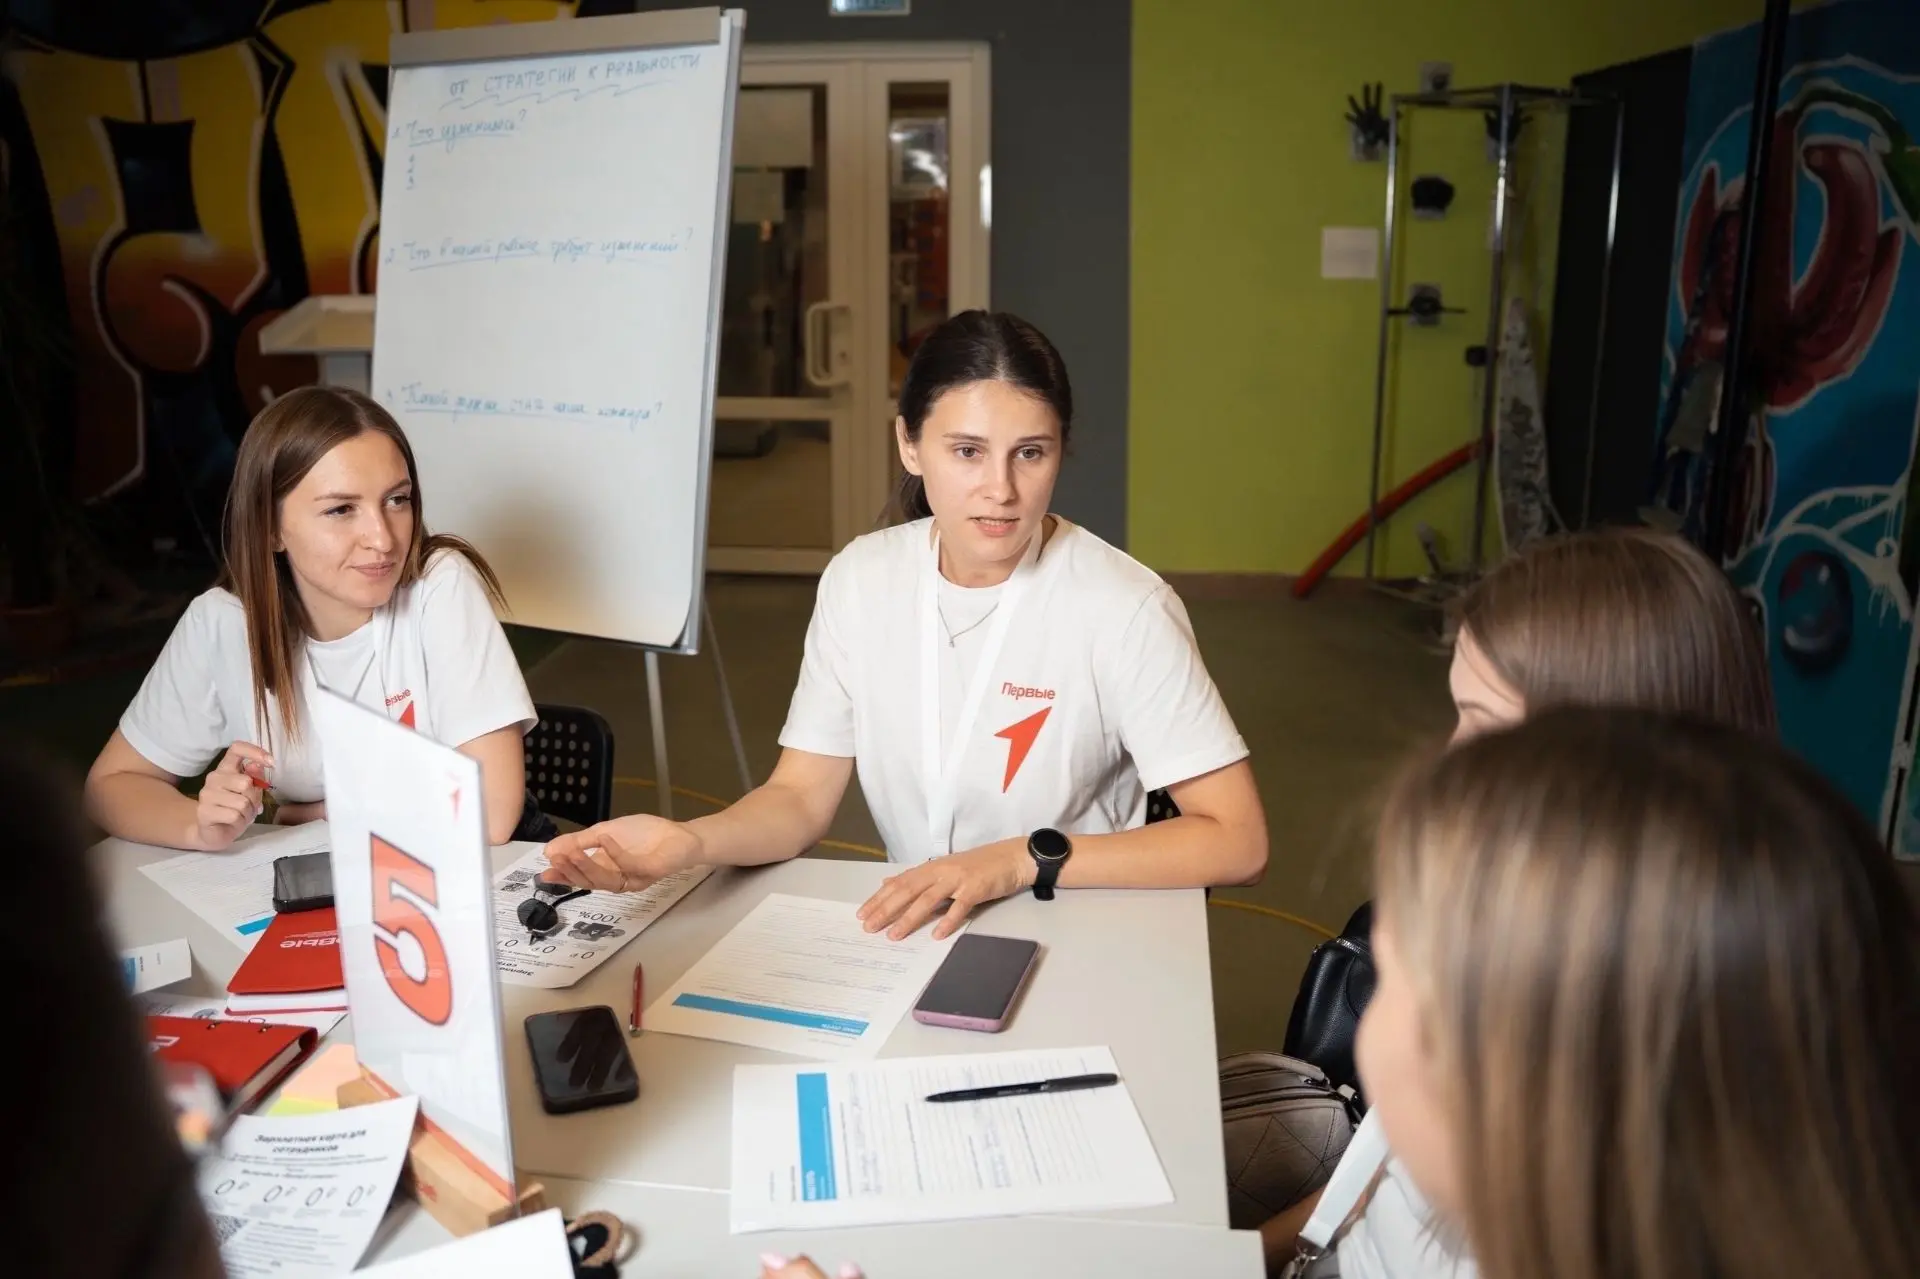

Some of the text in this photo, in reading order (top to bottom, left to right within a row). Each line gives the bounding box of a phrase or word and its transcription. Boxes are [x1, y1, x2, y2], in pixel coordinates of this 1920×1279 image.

[1001, 682, 1056, 701] Первые
[579, 911, 622, 925] 100%
[370, 831, 453, 1026] 5
